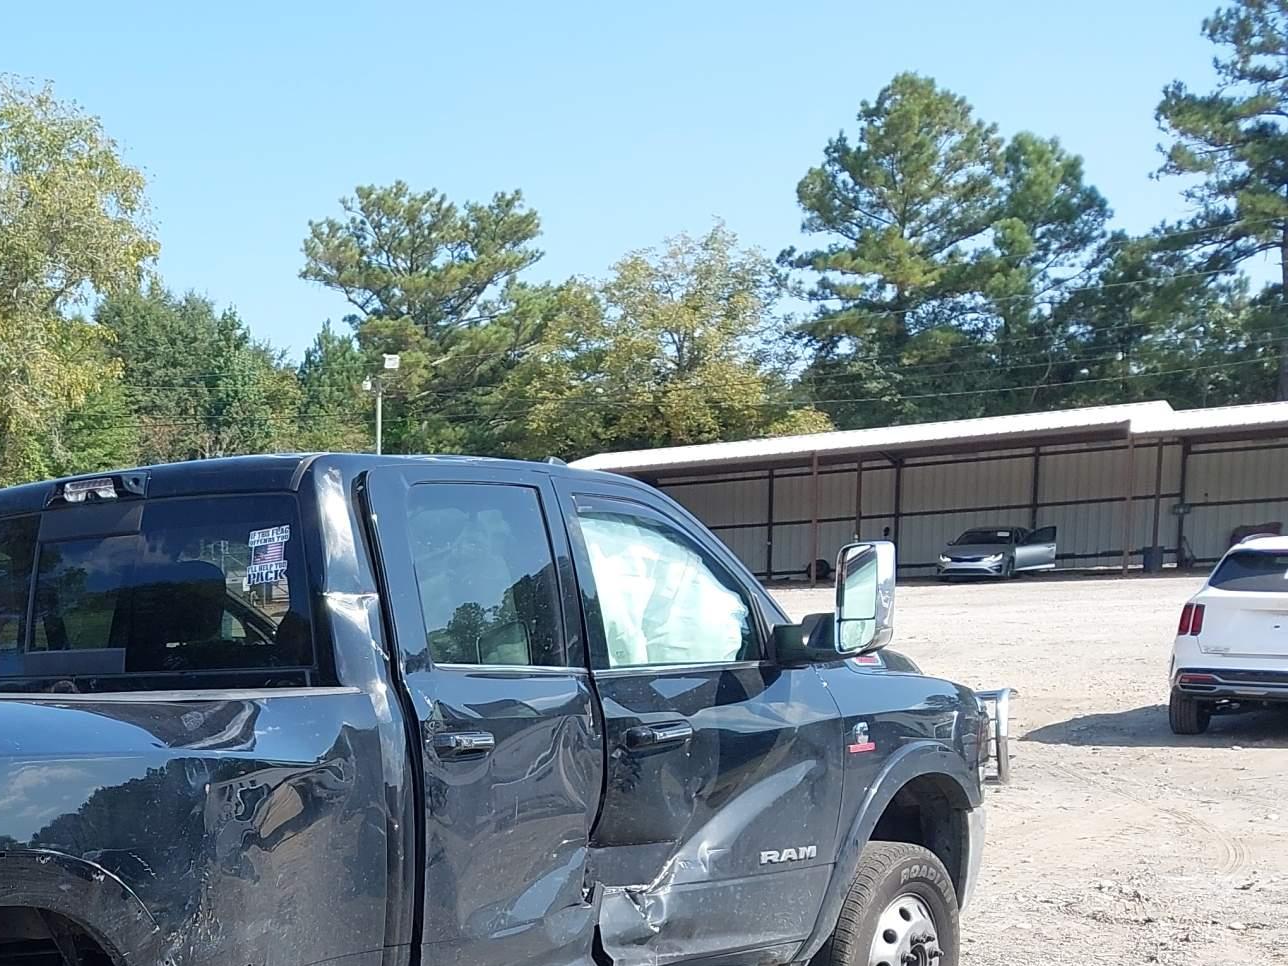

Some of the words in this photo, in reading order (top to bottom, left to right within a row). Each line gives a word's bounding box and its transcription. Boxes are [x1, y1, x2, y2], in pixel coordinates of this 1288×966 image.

[272, 527, 289, 536] FLAG
[259, 564, 274, 572] HELP
[248, 569, 288, 585] PACK
[759, 845, 817, 865] RAM
